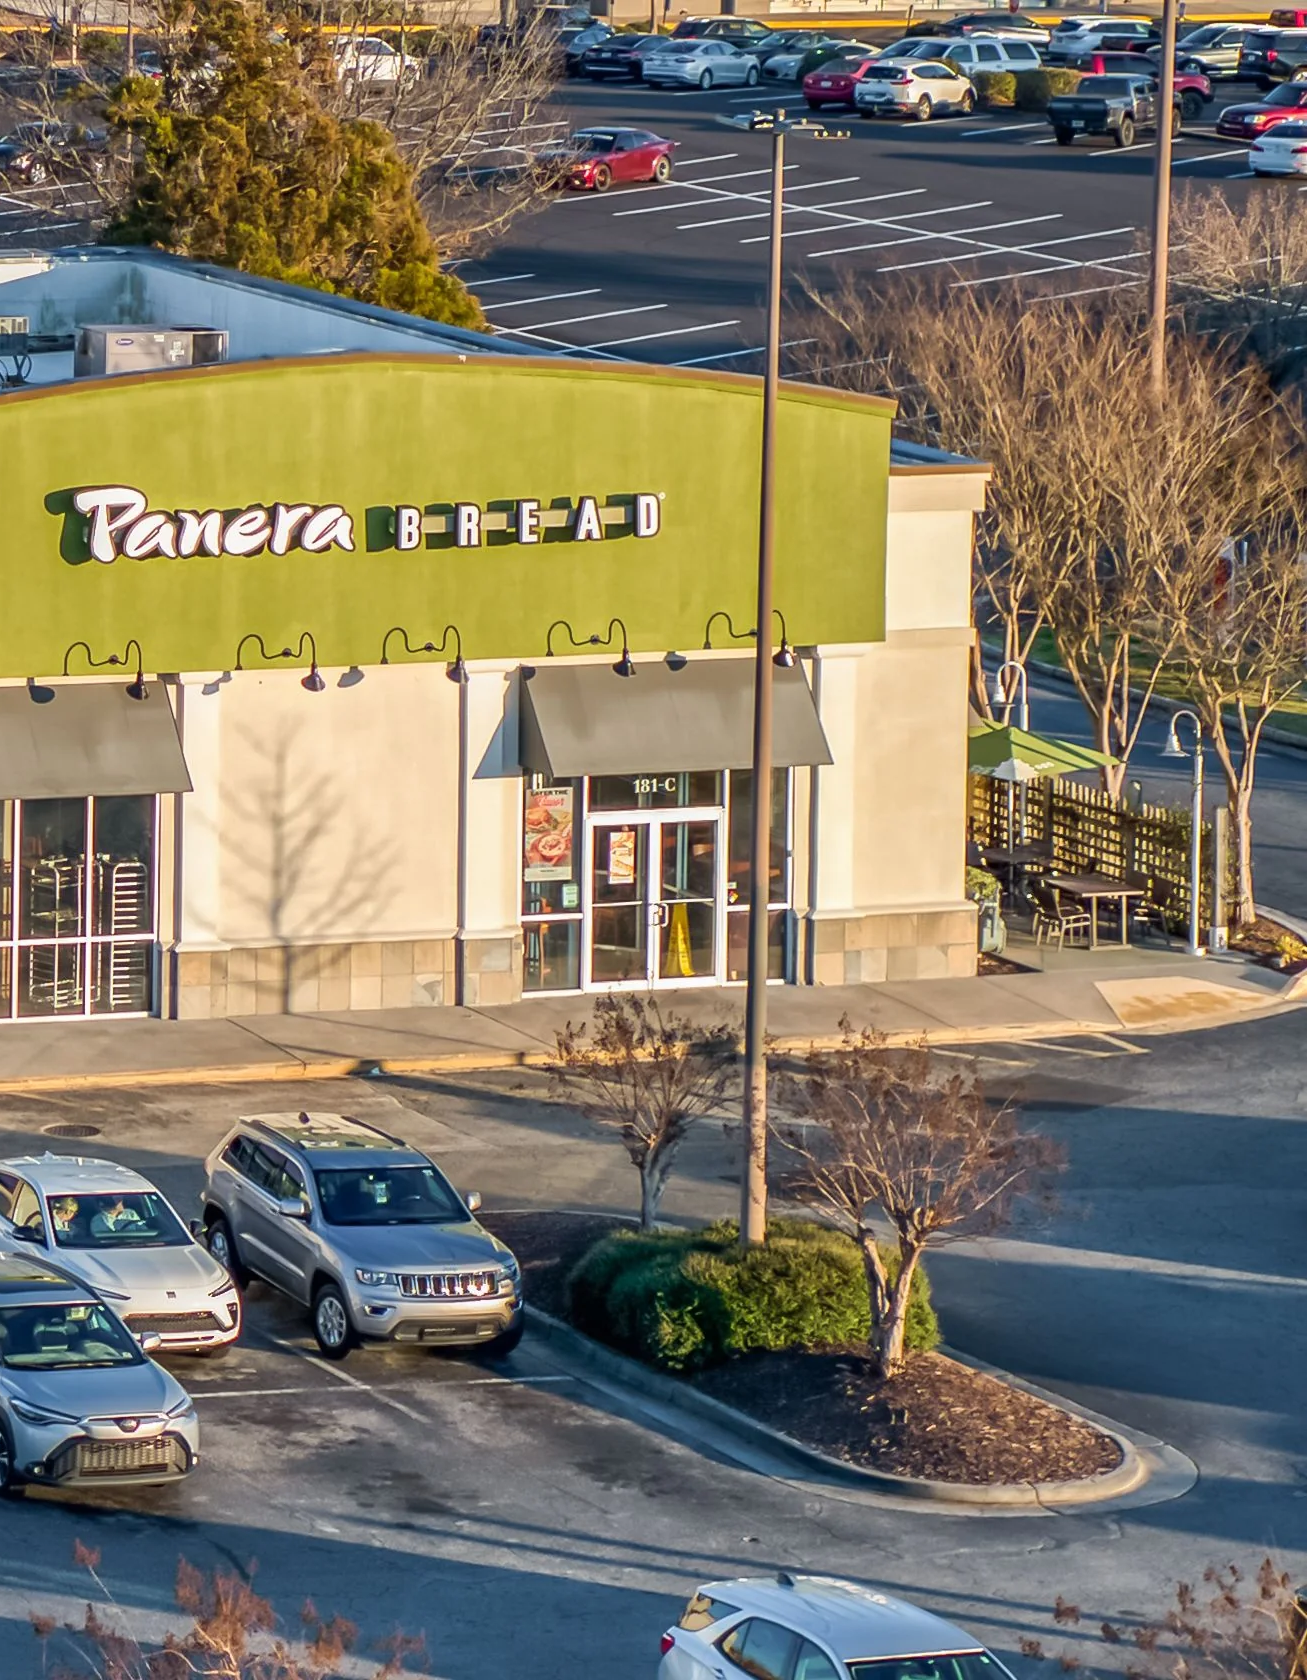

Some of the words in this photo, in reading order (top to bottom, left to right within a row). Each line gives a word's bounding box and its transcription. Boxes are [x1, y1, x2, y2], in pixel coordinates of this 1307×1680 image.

[74, 484, 356, 564] Panera
[396, 493, 660, 551] BREAD
[632, 777, 676, 794] 181-C
